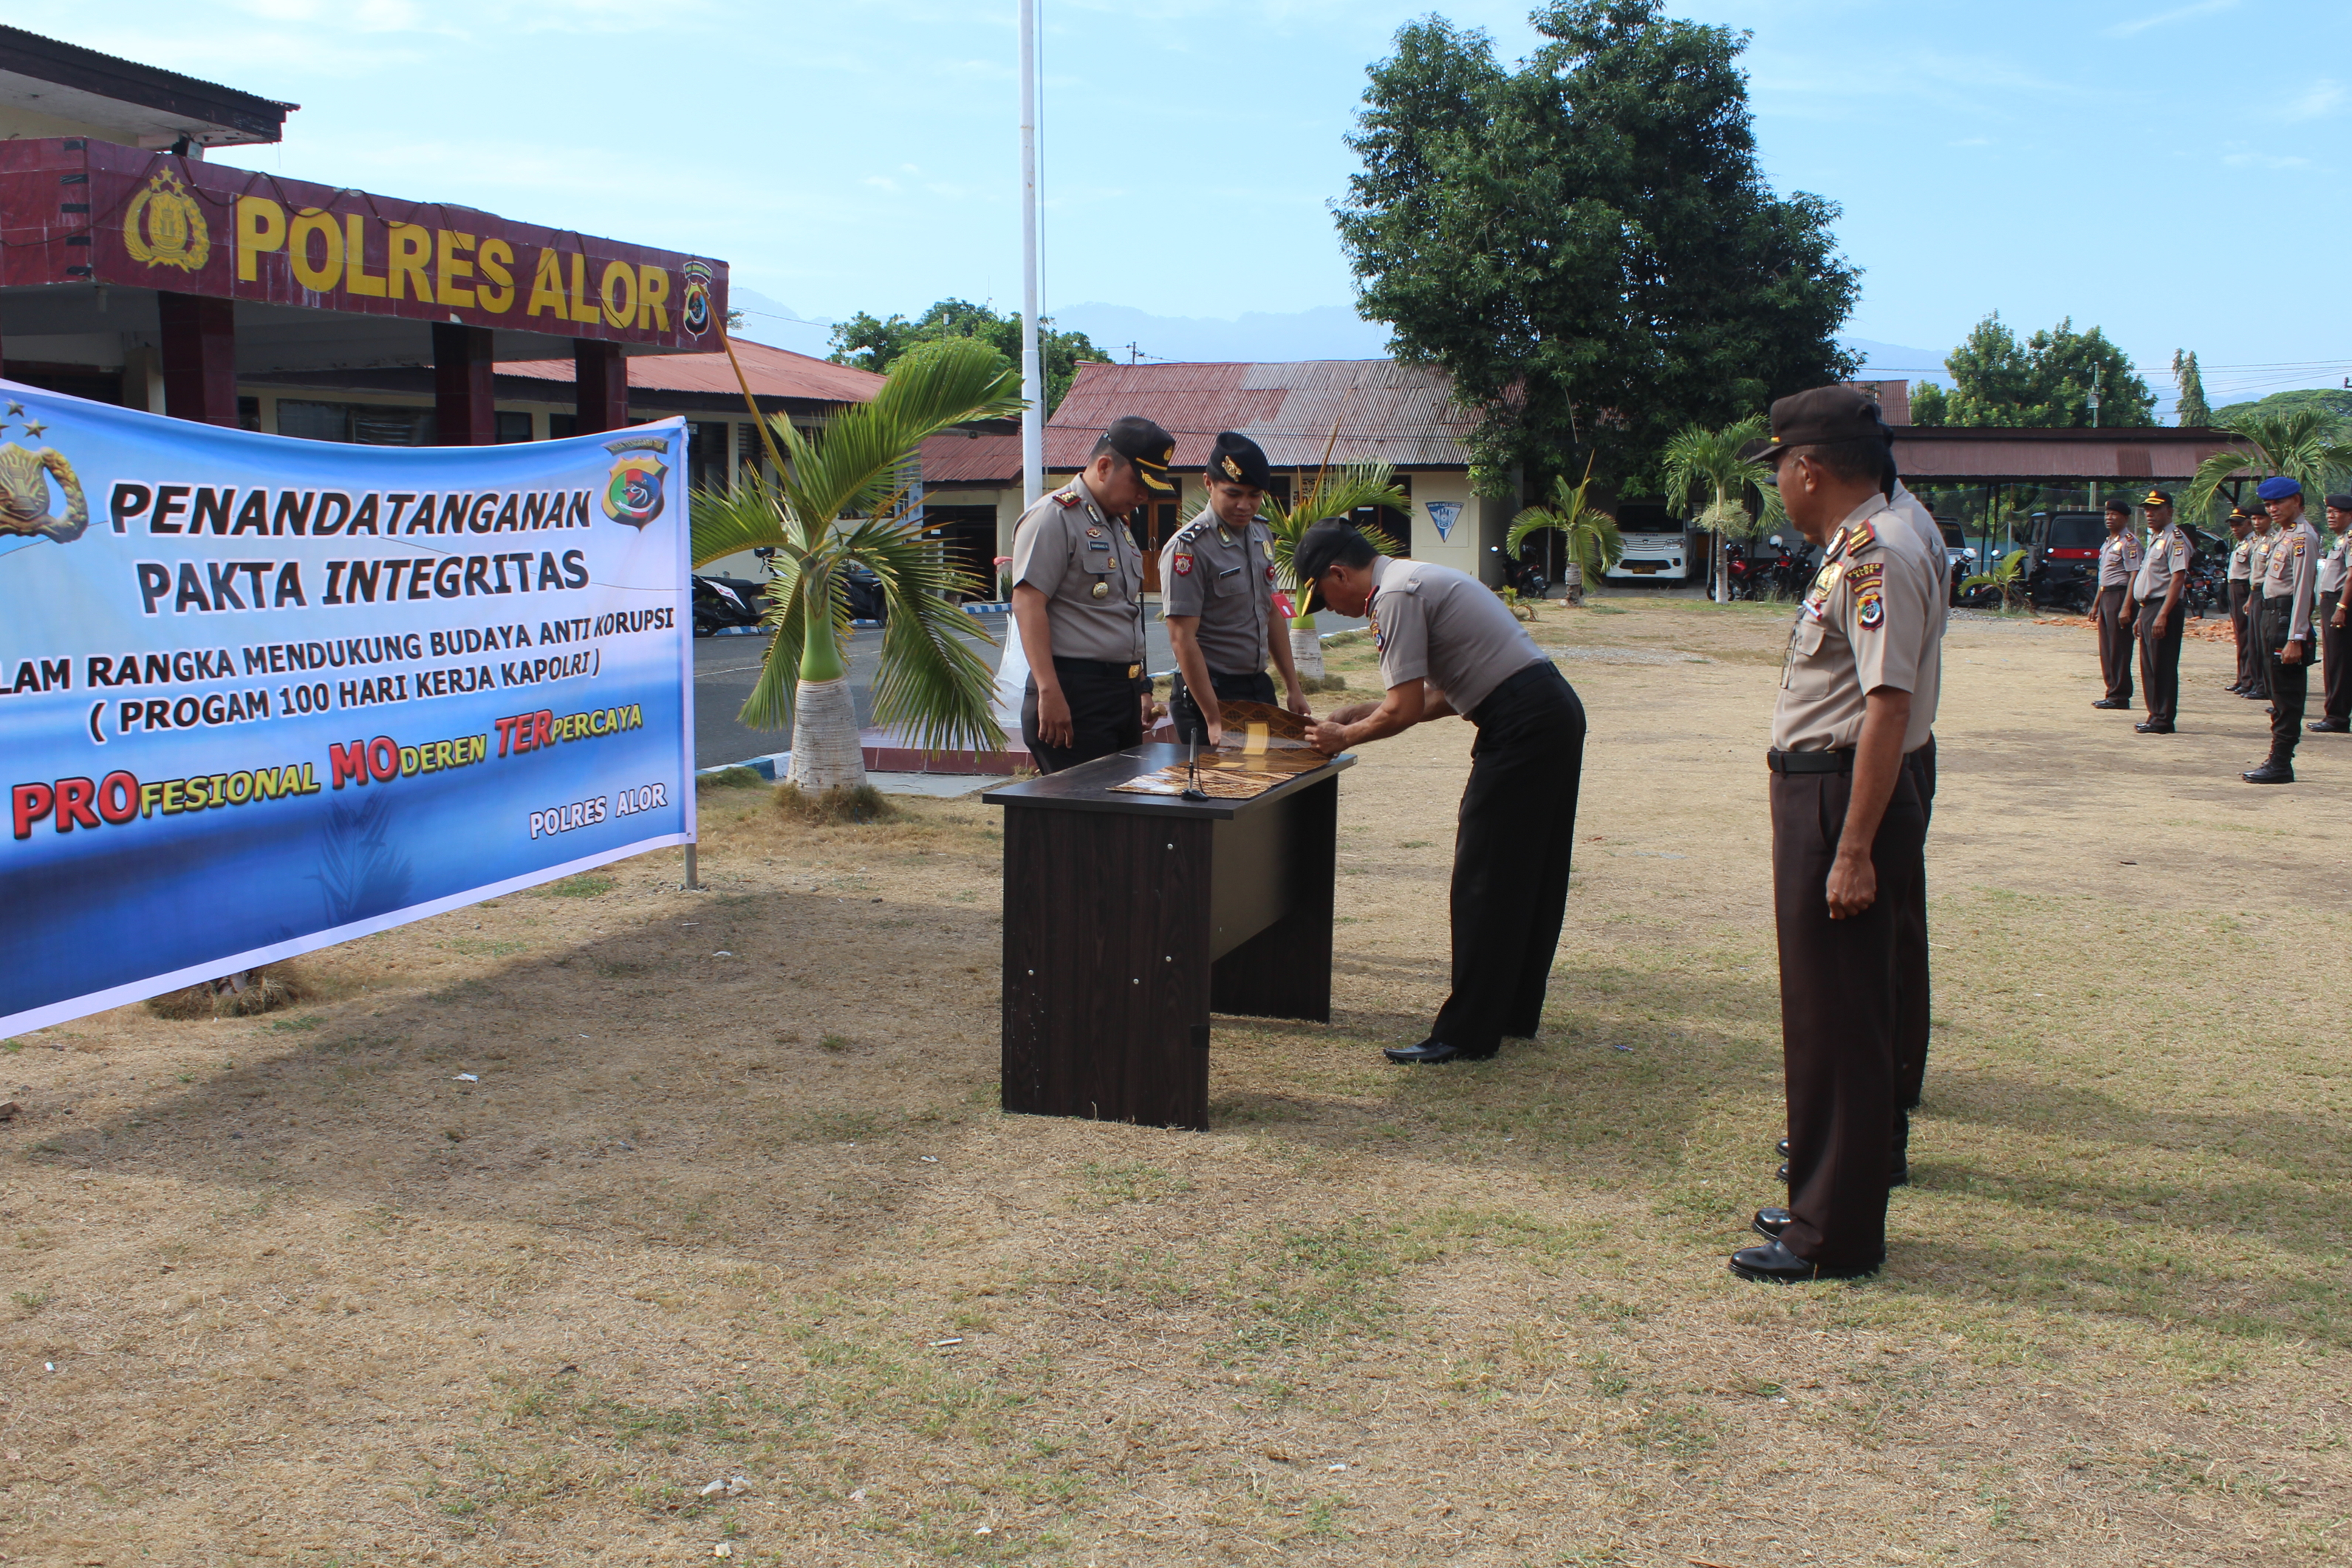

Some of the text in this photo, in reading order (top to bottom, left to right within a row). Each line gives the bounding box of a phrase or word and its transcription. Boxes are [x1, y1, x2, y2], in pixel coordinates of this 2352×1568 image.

[236, 196, 671, 332] POLRES ALOR
[111, 484, 592, 535] PENANDATANGANAN
[137, 550, 589, 613] PAKTA INTEGRITAS
[1847, 564, 1880, 578] POLRES
[87, 650, 236, 688] RANGKA
[244, 634, 422, 674] MENDUKUNG
[431, 624, 532, 656] BUDAYA
[540, 618, 592, 645] ANTI
[594, 607, 674, 637] KORUPSI
[120, 691, 270, 732] PROGAM
[281, 683, 329, 715] 100
[339, 676, 407, 708] HARI
[416, 665, 496, 698] KERJA
[501, 651, 590, 686] KAPOLRI
[12, 703, 642, 840] PROFESIONAL MODEREN TERPERCAYA
[529, 783, 666, 840] POLRES ALOR
